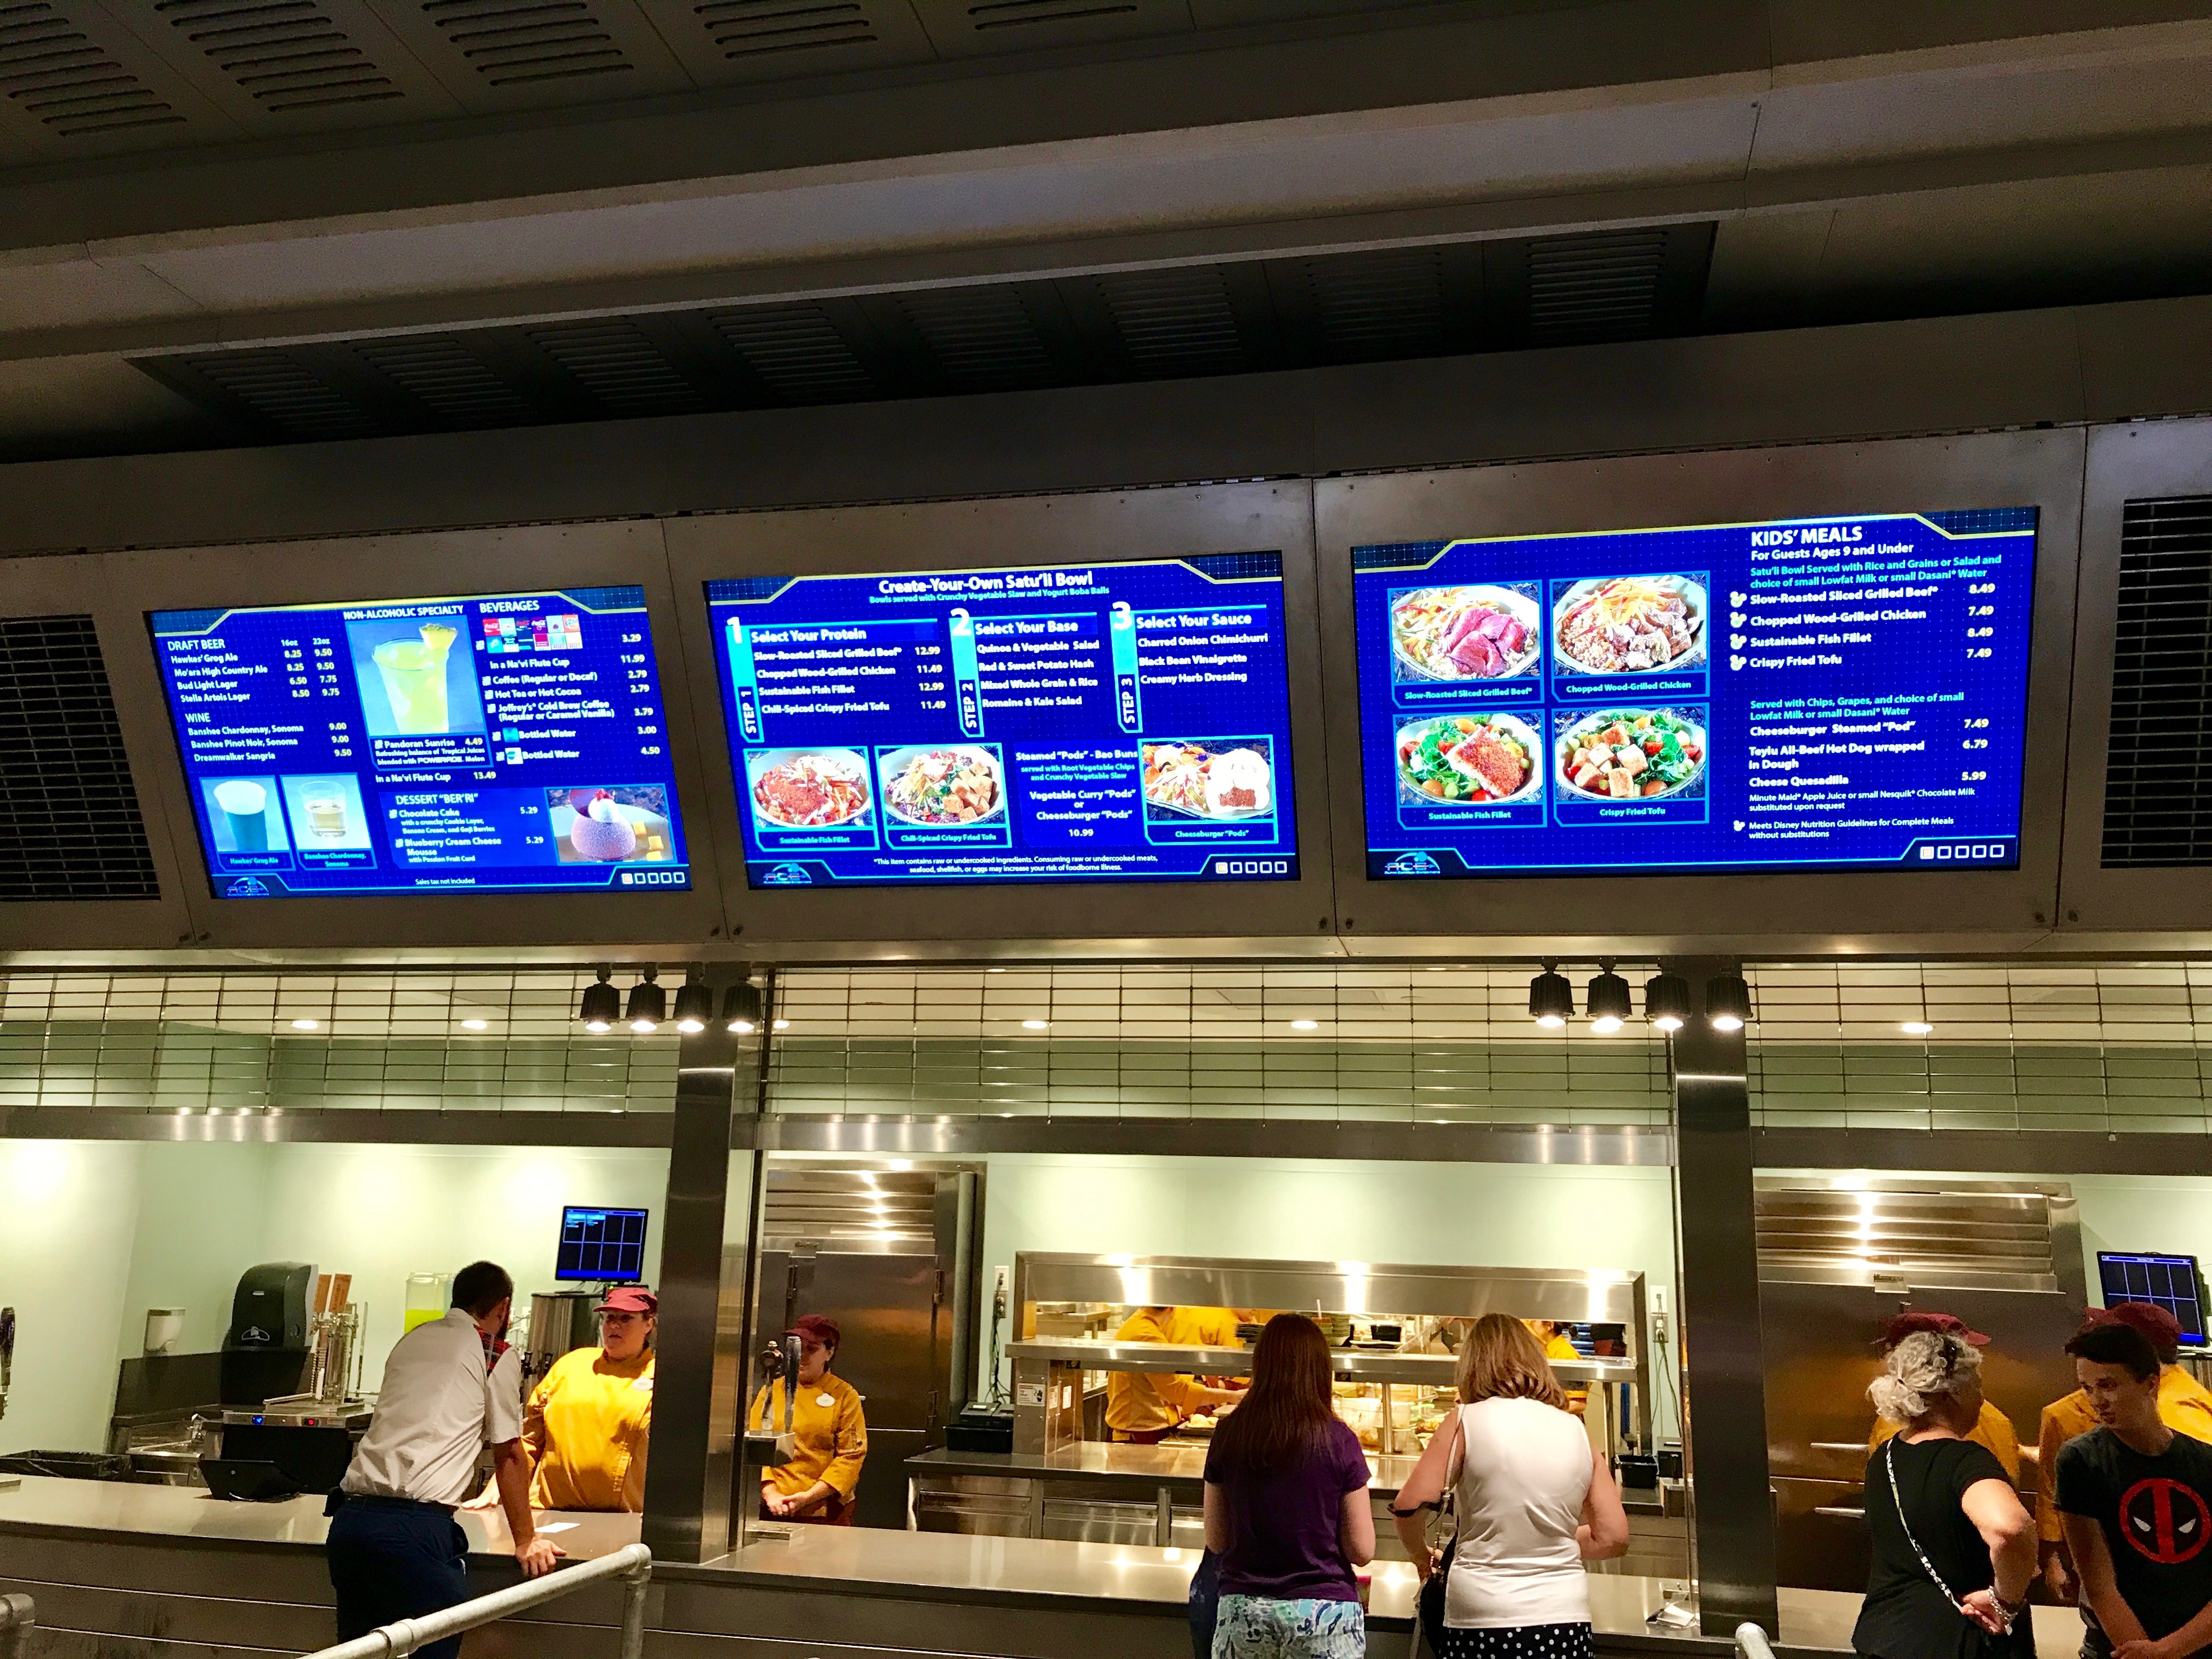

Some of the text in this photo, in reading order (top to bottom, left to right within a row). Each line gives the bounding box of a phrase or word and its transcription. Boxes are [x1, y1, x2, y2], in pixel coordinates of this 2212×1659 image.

[1752, 527, 1862, 546] KIDS' MEALS
[1751, 543, 1914, 561] For Guests Ages 9 and Under
[1781, 565, 1804, 574] Bowl
[1807, 563, 1839, 573] Served
[1842, 562, 1863, 572] with
[1865, 562, 1884, 570] Rice
[1887, 560, 1905, 569] and
[1908, 559, 1938, 568] Grains
[1954, 556, 1980, 566] Salad
[1982, 555, 2001, 564] and
[879, 576, 1002, 593] Create-Your-Own
[1056, 571, 1092, 586] Bowl
[1969, 584, 1995, 594] 8.49
[1751, 591, 1826, 605] Slow-Roasted
[1829, 590, 1863, 601] Sliced
[1865, 588, 1904, 599] Grilled
[343, 600, 539, 619] NON-ALCOHOLIC SPECIALTY BEVERAGES
[1968, 606, 1994, 616] 7.49
[1113, 601, 1132, 630] 3
[1751, 610, 1926, 627] Chopped Wood-Grilled Chicken
[950, 608, 972, 635] 2
[1136, 614, 1251, 629] Select Your Sauce
[727, 617, 742, 643] 1
[975, 620, 1078, 635] Select Your Base
[1967, 627, 1993, 637] 8.49
[752, 629, 866, 643] Select Your Protein
[1138, 634, 1268, 647] Charred Onion Chimichurri
[1751, 633, 1871, 647] Sustainable Fish Fillet
[167, 639, 225, 651] DRAFT BEER
[915, 646, 940, 655] 12.99
[977, 640, 1099, 653] Quinoa & Vegetable Salad
[284, 650, 302, 658] 8.25
[314, 648, 332, 656] 9.50
[1967, 648, 1991, 658] 7.49
[204, 654, 224, 663] Grog
[225, 653, 238, 661] Ale
[529, 659, 551, 667] Flute
[552, 658, 569, 668] Cup
[620, 654, 645, 663] 11.99
[1139, 654, 1247, 666] Black Bean Vinaigrette
[1750, 654, 1842, 668] Crispy Fried Tofu
[202, 667, 221, 677] High
[222, 667, 253, 675] Country
[255, 665, 268, 673] Ale
[287, 663, 304, 672] 8.25
[917, 664, 943, 673] 11.49
[320, 675, 337, 683] 7.75
[177, 680, 238, 690] Bud Light Lager
[919, 682, 944, 691] 12.99
[921, 701, 946, 709] 11.49
[962, 683, 977, 727] STEP 2
[1122, 691, 1135, 723] STEP
[185, 713, 211, 723] WINE
[743, 702, 757, 733] STEP
[1964, 718, 1989, 728] 7.49
[222, 726, 270, 735] Chardonnay,
[1750, 725, 1827, 736] Cheeseburger
[1832, 722, 1881, 733] Steamed
[1749, 741, 1925, 757] Teylu All-Beef Hot Dog wrapped
[1962, 739, 1988, 749] 6.79
[1016, 751, 1056, 760] Steamed
[1115, 749, 1138, 758] Buns
[1749, 758, 1799, 769] in Dough
[1750, 775, 1849, 787] Cheese Quesadilla
[1962, 771, 1986, 781] 5.99
[396, 794, 438, 804] DESSERT
[1030, 791, 1076, 801] Vegetable
[1078, 791, 1103, 800] Curry
[399, 808, 460, 817] Chocolate Cake
[1892, 818, 1929, 826] Complete
